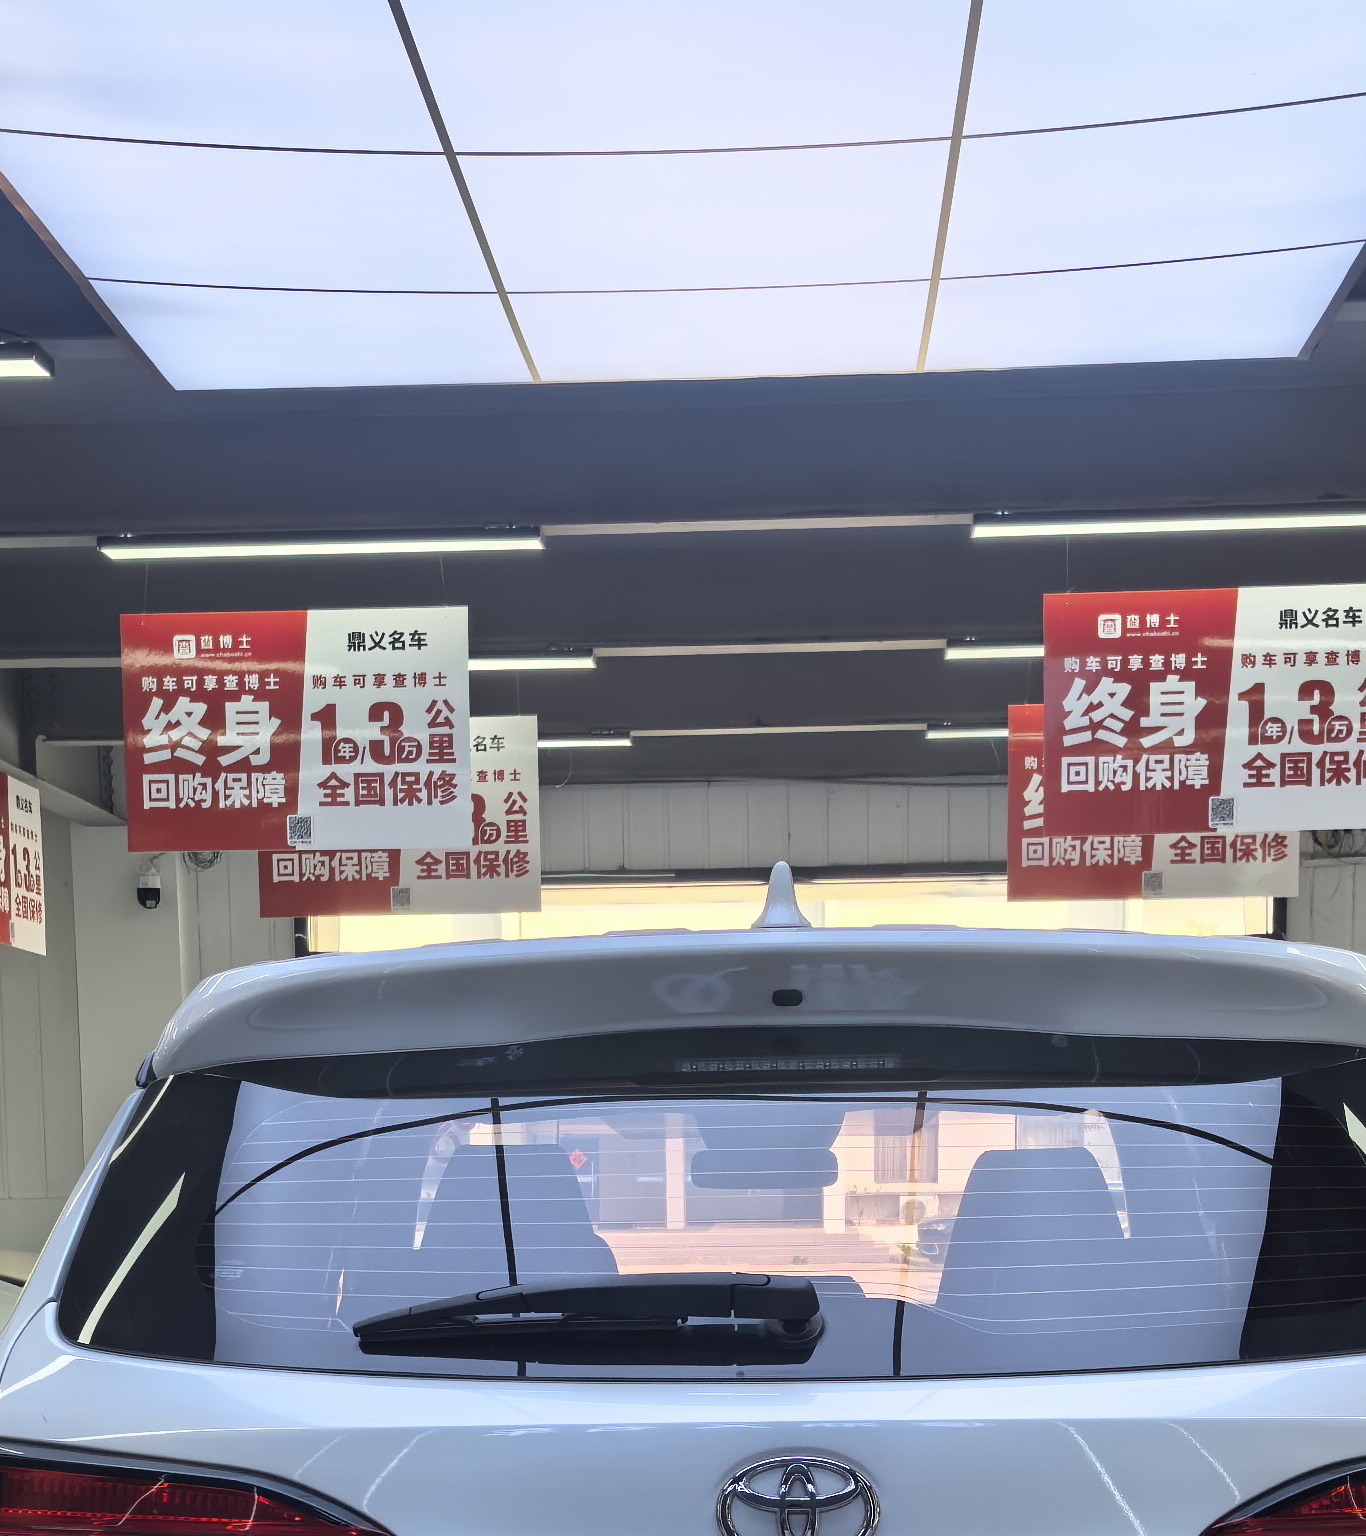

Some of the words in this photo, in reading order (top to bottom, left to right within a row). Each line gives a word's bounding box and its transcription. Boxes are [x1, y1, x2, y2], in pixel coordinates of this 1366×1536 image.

[1126, 613, 1180, 629] 查博士
[1278, 606, 1363, 630] 鼎义名车
[200, 633, 252, 650] 查博士
[347, 629, 428, 652] 鼎义名车
[1064, 653, 1207, 673] 购车可享查博士
[141, 672, 280, 693] 购车可享查博士
[312, 671, 448, 690] 购车可享查博士
[1062, 675, 1207, 749] 终身
[142, 695, 281, 767] 终身
[470, 734, 506, 752] 名车
[470, 768, 521, 783] 查博士
[1024, 756, 1044, 770] 购
[1061, 752, 1210, 793] 回购保障
[142, 770, 287, 811] 回购保障
[317, 771, 458, 808] 全国保修
[1022, 835, 1143, 868] 回购保障
[1169, 833, 1288, 865] 全国保修
[272, 852, 391, 883] 回购保障
[415, 850, 530, 880] 全国保修
[15, 893, 43, 924] 全国保修
